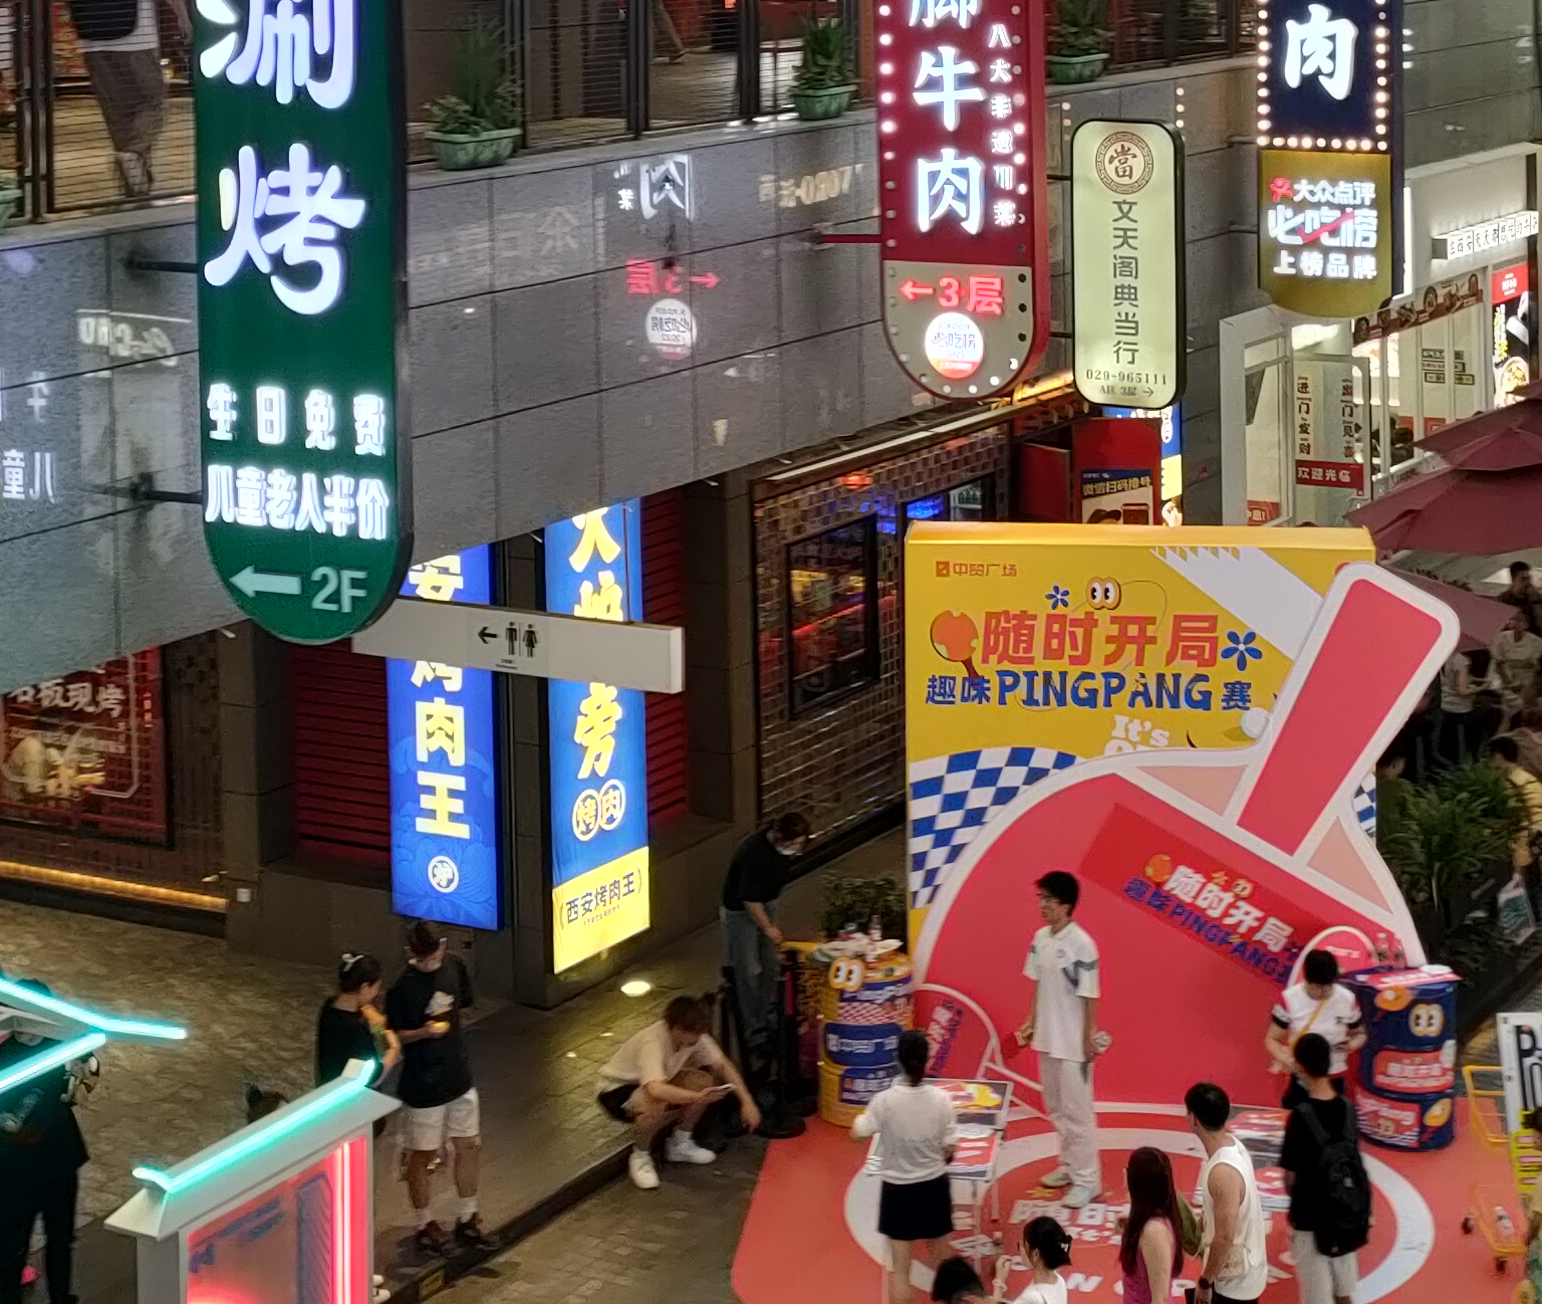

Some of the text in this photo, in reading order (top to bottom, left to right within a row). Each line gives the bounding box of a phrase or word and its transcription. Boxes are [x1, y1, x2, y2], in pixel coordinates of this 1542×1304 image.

[1293, 179, 1376, 205] 大众点评
[1268, 204, 1378, 248] 必吃榜
[1112, 199, 1139, 365] 文天阁典当行
[1273, 250, 1378, 279] 上榜品牌
[938, 276, 1003, 314] 3层
[206, 384, 387, 456] 生日免费
[205, 462, 390, 541] 儿童老人半价
[311, 567, 367, 614] 2F
[953, 562, 1018, 578] 中贸广场
[981, 610, 1219, 668] 随时开局
[1163, 864, 1295, 953] 随时开局
